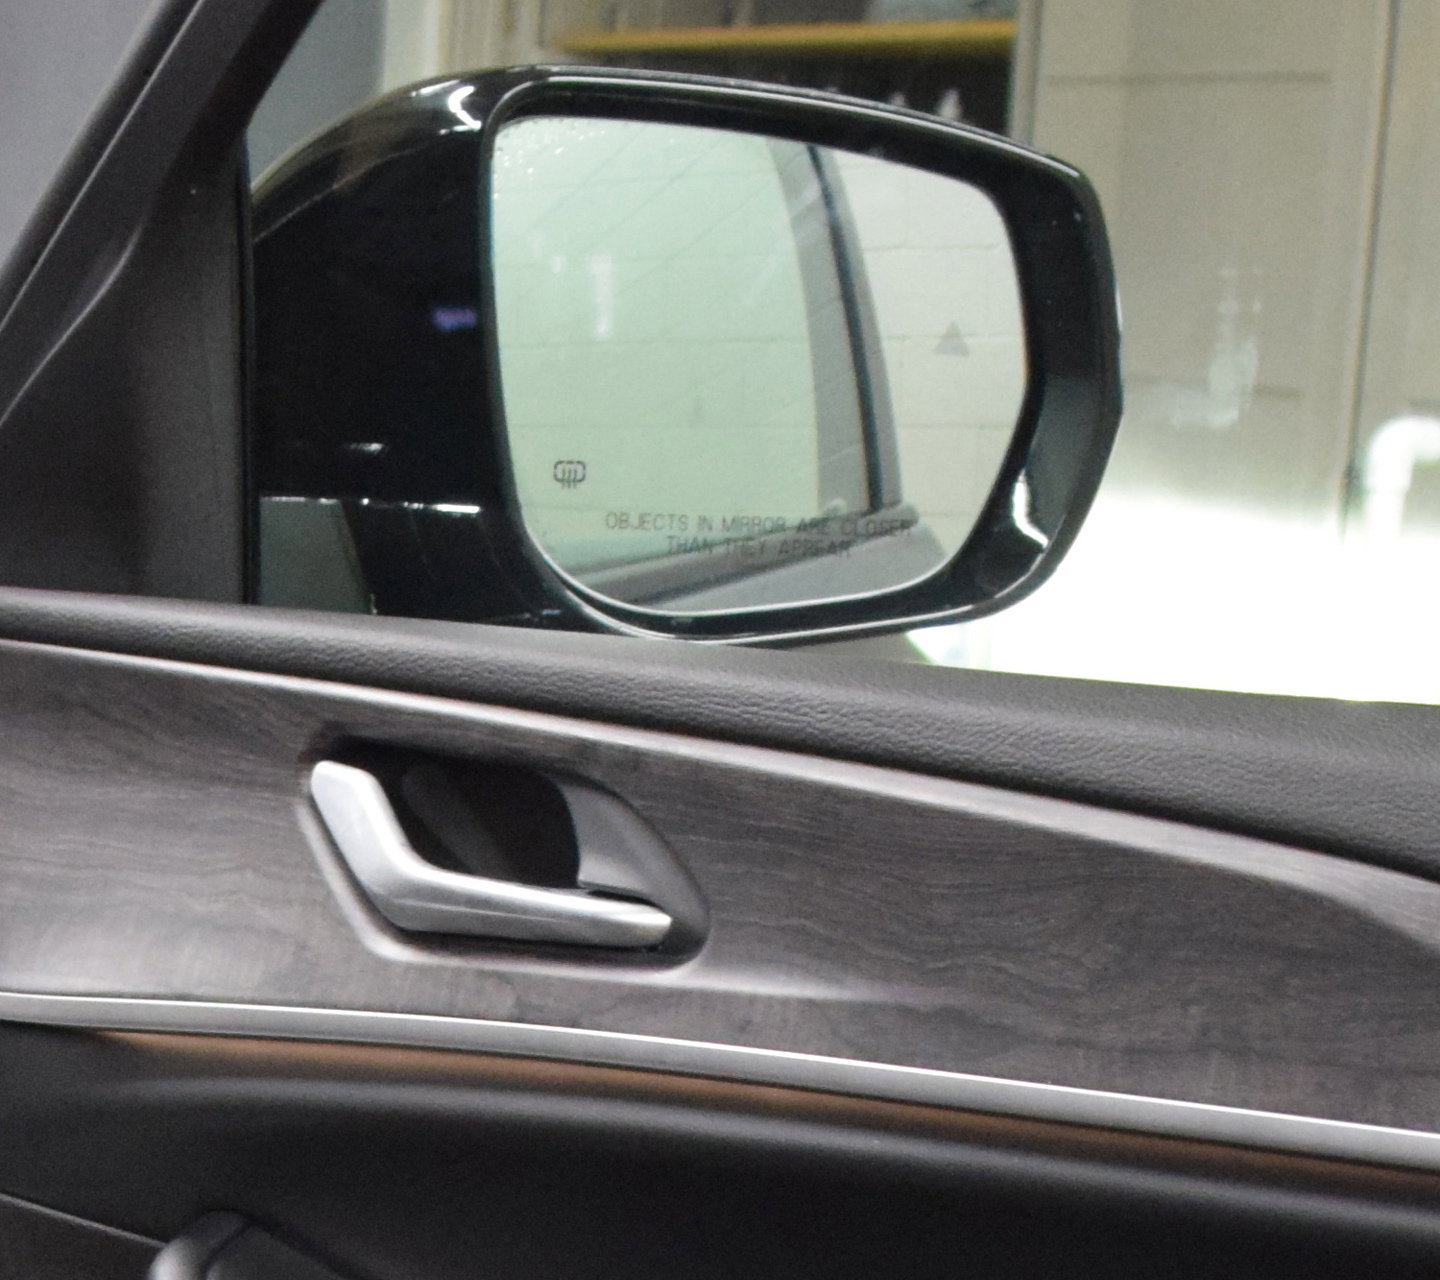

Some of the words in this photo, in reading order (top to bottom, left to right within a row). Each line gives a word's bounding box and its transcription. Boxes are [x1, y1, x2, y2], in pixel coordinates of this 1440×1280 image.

[605, 512, 689, 531] OBJECTS
[697, 514, 713, 531] IN
[721, 515, 788, 533] MIRROR
[666, 535, 714, 554] THAN
